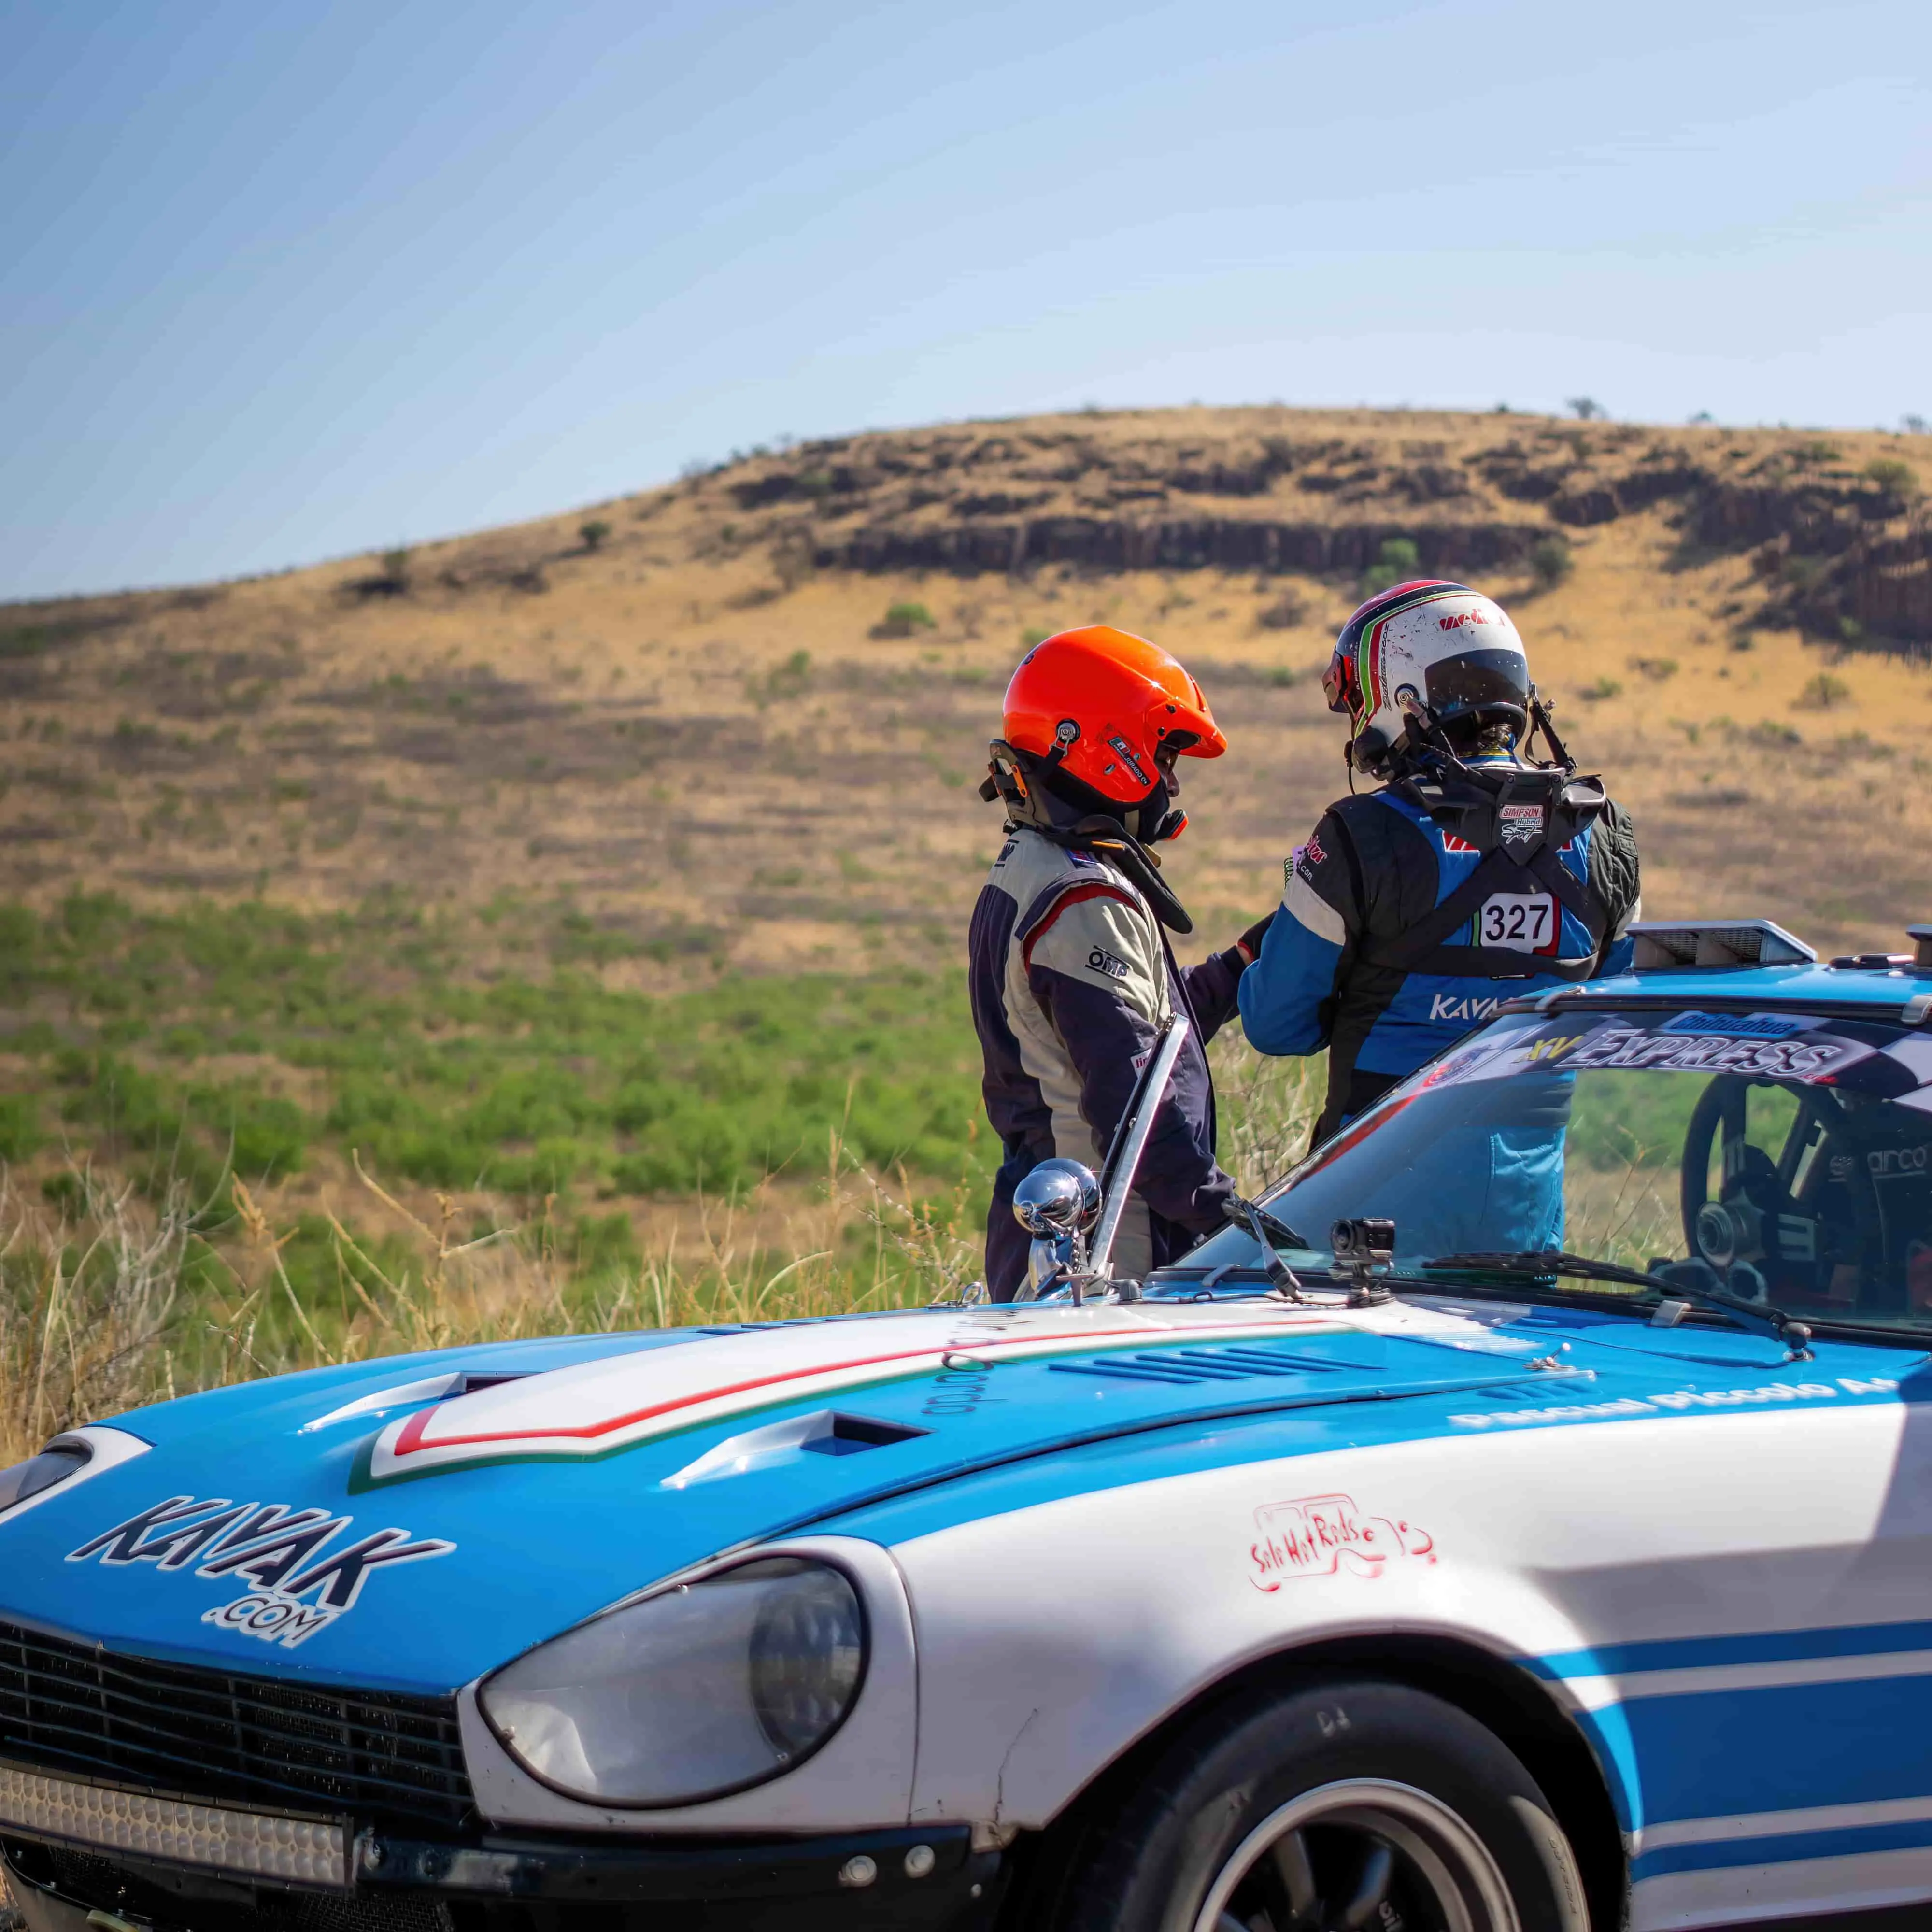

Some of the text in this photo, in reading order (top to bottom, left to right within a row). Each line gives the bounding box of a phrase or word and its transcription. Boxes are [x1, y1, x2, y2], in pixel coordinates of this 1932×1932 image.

[1124, 757, 1142, 777] JURADO
[1503, 807, 1539, 816] SIMPSON
[1485, 904, 1548, 940] 327
[1089, 951, 1127, 977] OMP
[1429, 994, 1498, 1020] KAVA
[1671, 1015, 1796, 1035] Chihuahua
[1553, 1028, 1842, 1076] EXPRESS
[1646, 1383, 1837, 1409] Piccolo
[64, 1495, 457, 1613] KAVAK
[201, 1593, 342, 1649] .COM
